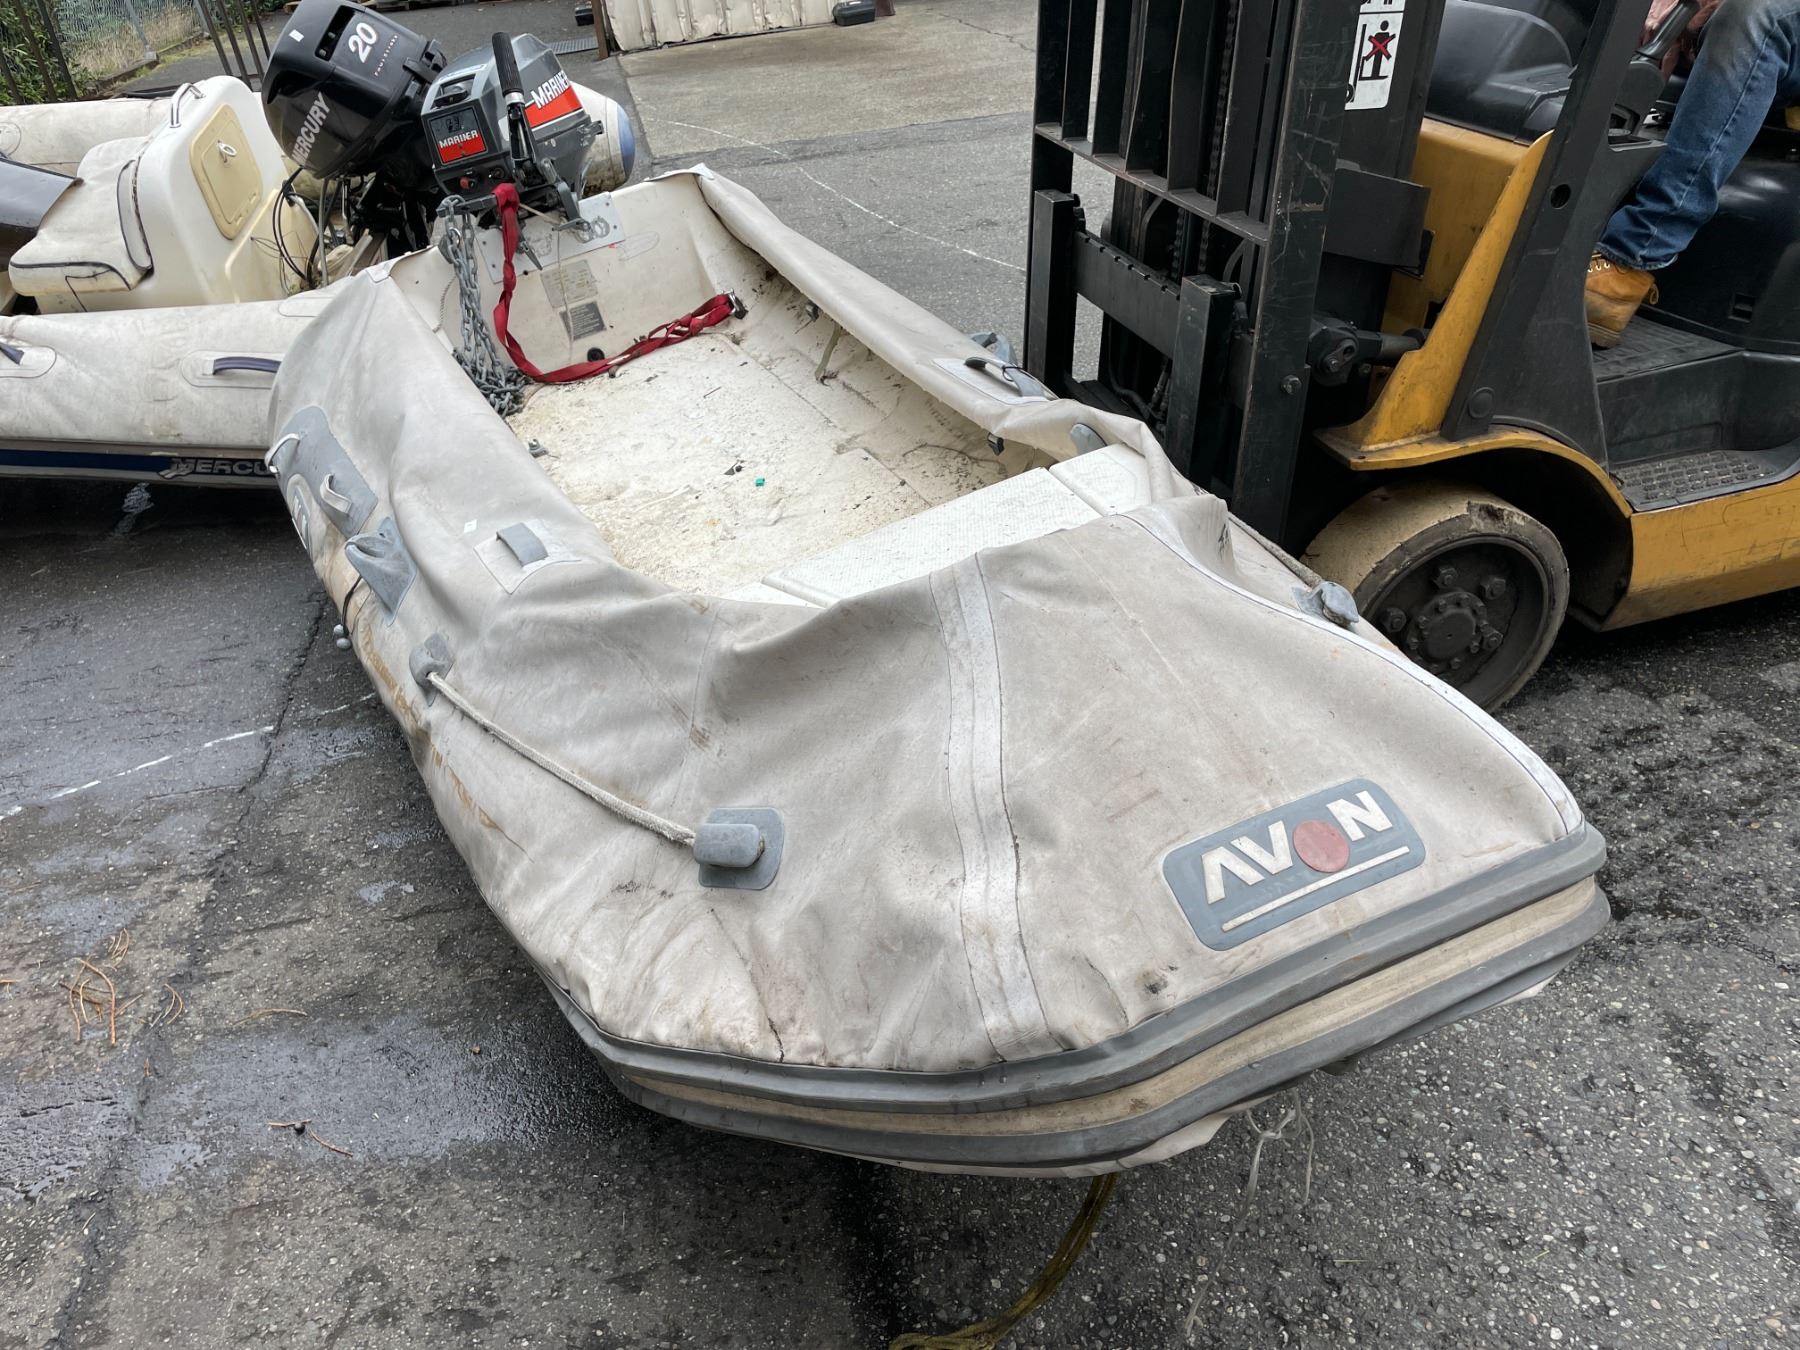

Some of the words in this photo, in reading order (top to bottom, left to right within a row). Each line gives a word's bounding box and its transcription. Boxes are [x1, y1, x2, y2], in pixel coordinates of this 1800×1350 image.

[348, 22, 378, 63] 20
[291, 91, 331, 166] MERCURY
[438, 130, 479, 149] MARINER
[172, 457, 271, 476] MERCU
[1202, 790, 1392, 904] AVON
